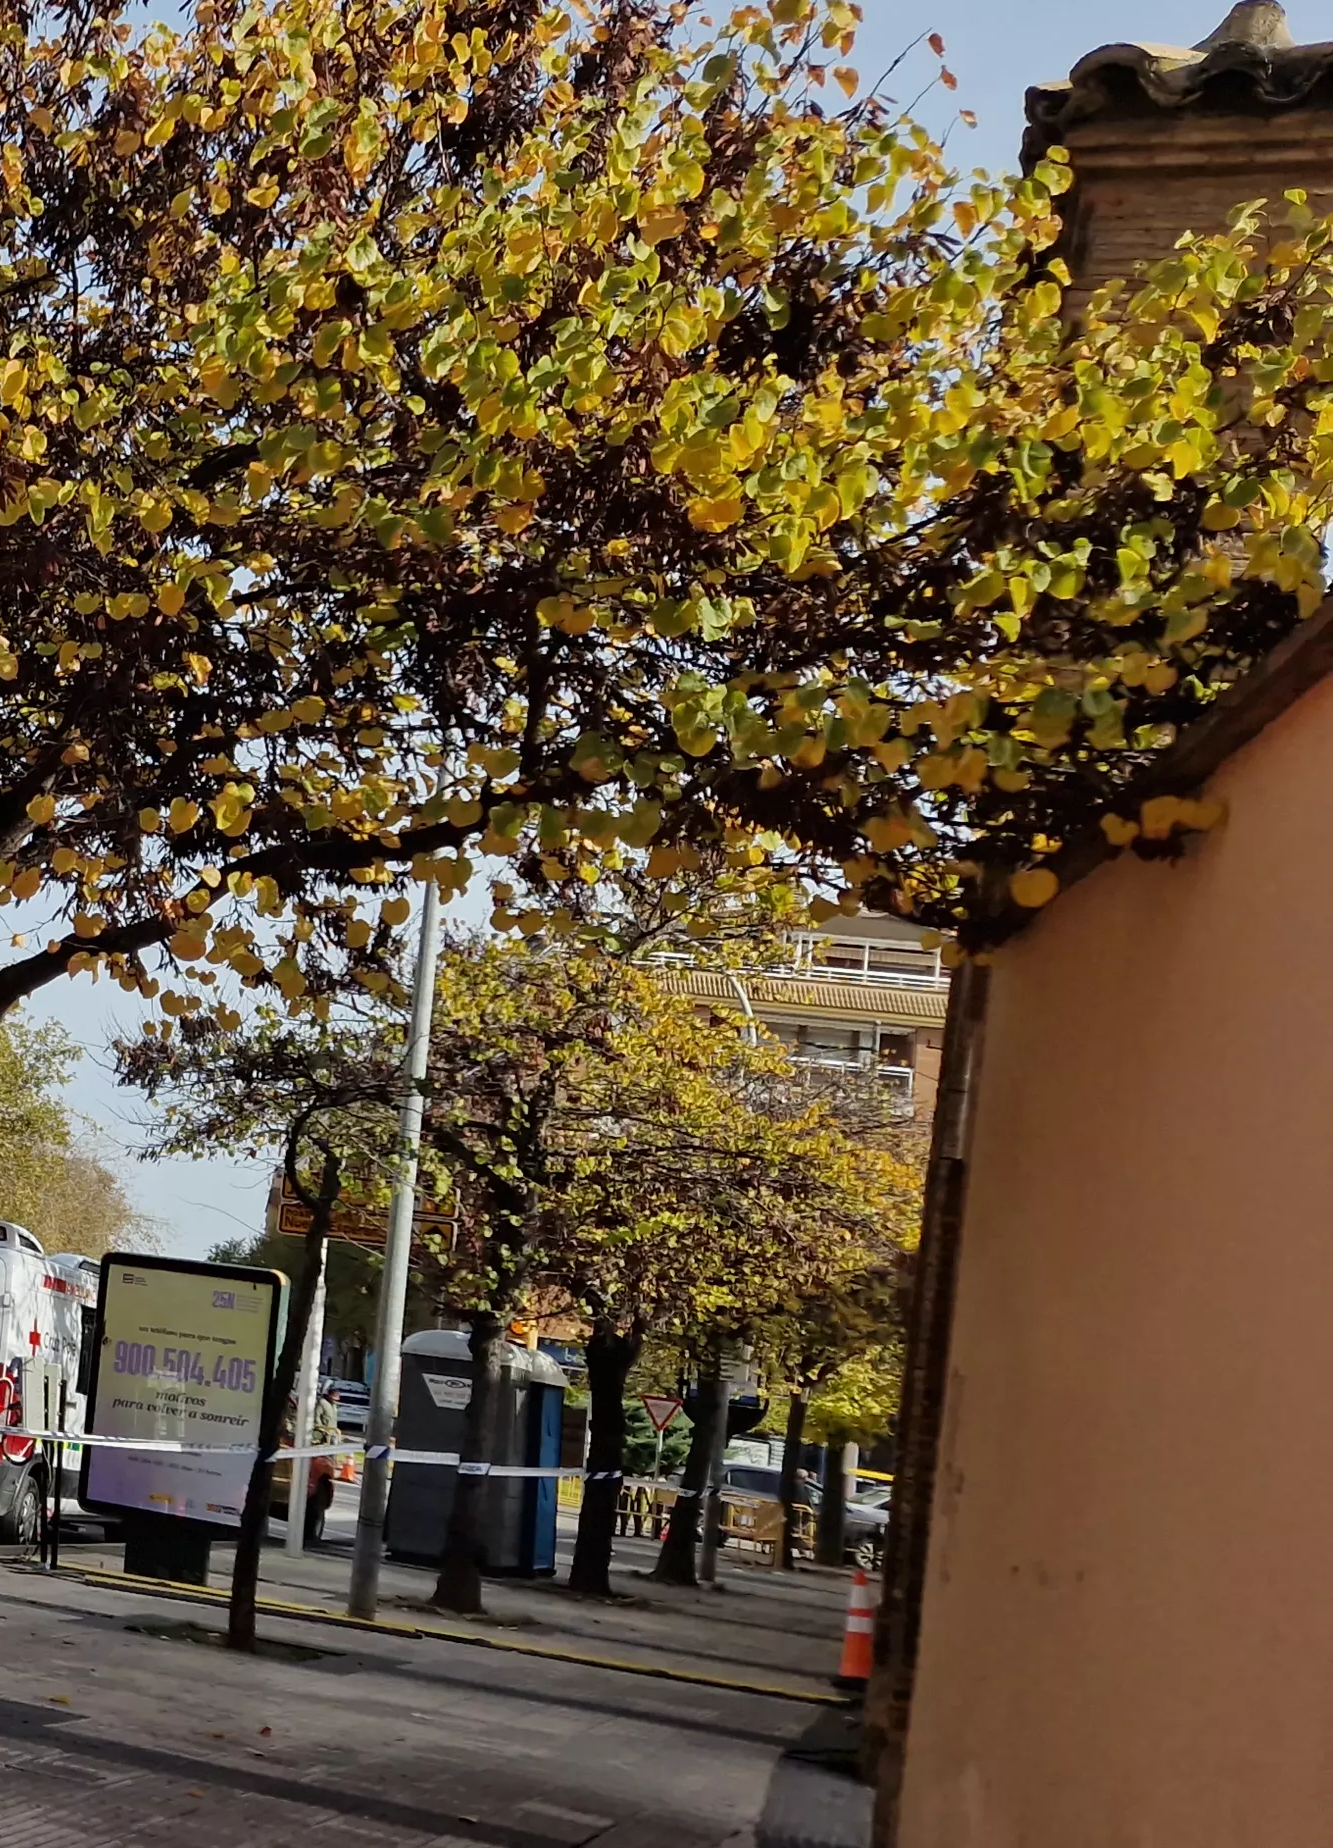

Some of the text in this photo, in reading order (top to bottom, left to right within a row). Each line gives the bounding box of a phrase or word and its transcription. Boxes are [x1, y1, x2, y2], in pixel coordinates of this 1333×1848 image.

[113, 1340, 257, 1393] 900504.405
[112, 1397, 144, 1410] para
[147, 1404, 187, 1417] volver
[188, 1411, 199, 1419] a
